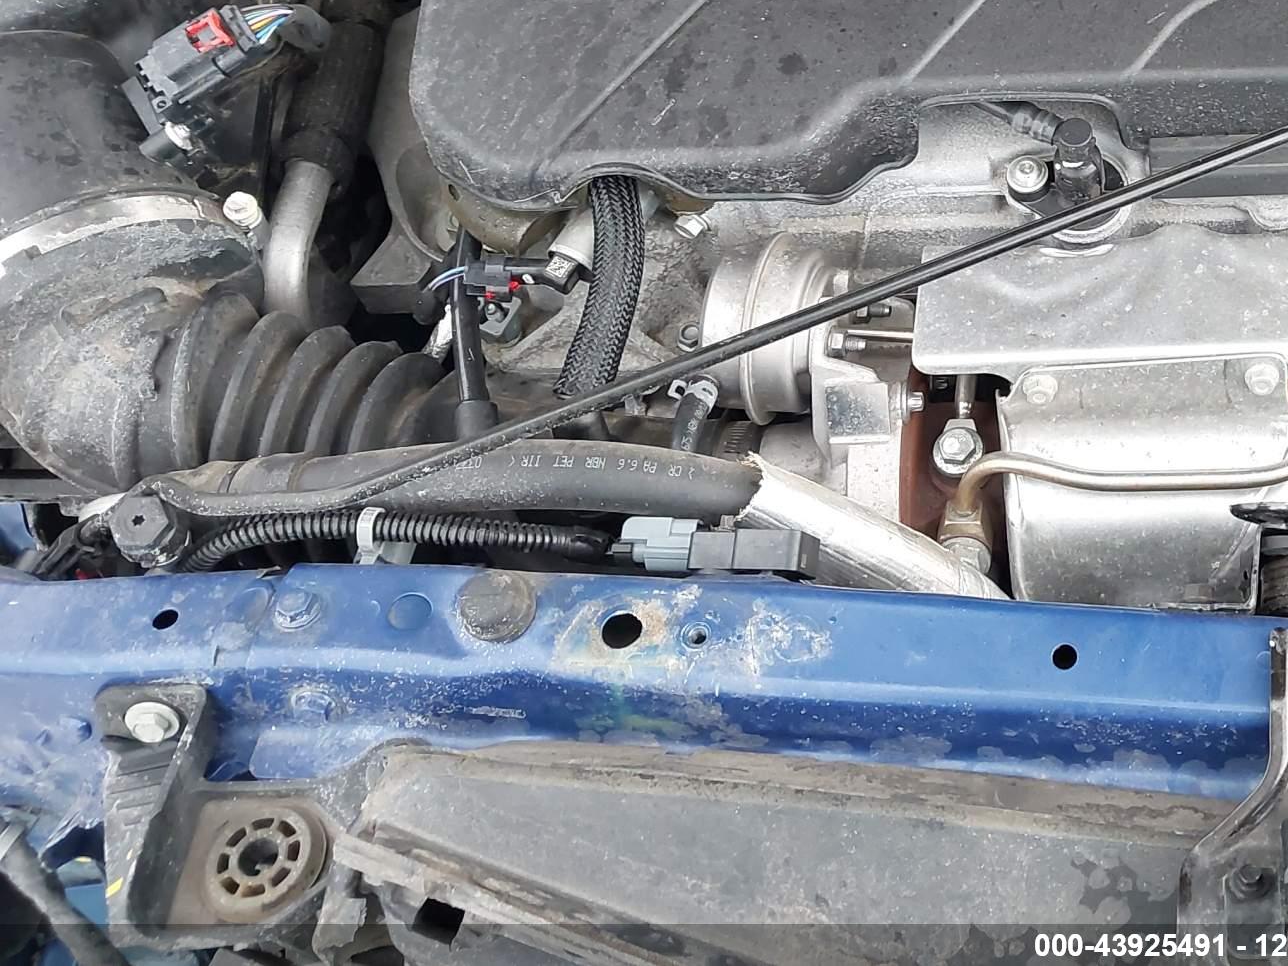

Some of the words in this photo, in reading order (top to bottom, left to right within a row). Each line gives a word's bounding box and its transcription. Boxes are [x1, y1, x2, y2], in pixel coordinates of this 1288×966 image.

[553, 456, 574, 468] PET
[585, 456, 606, 470] NBR
[643, 460, 658, 474] PA
